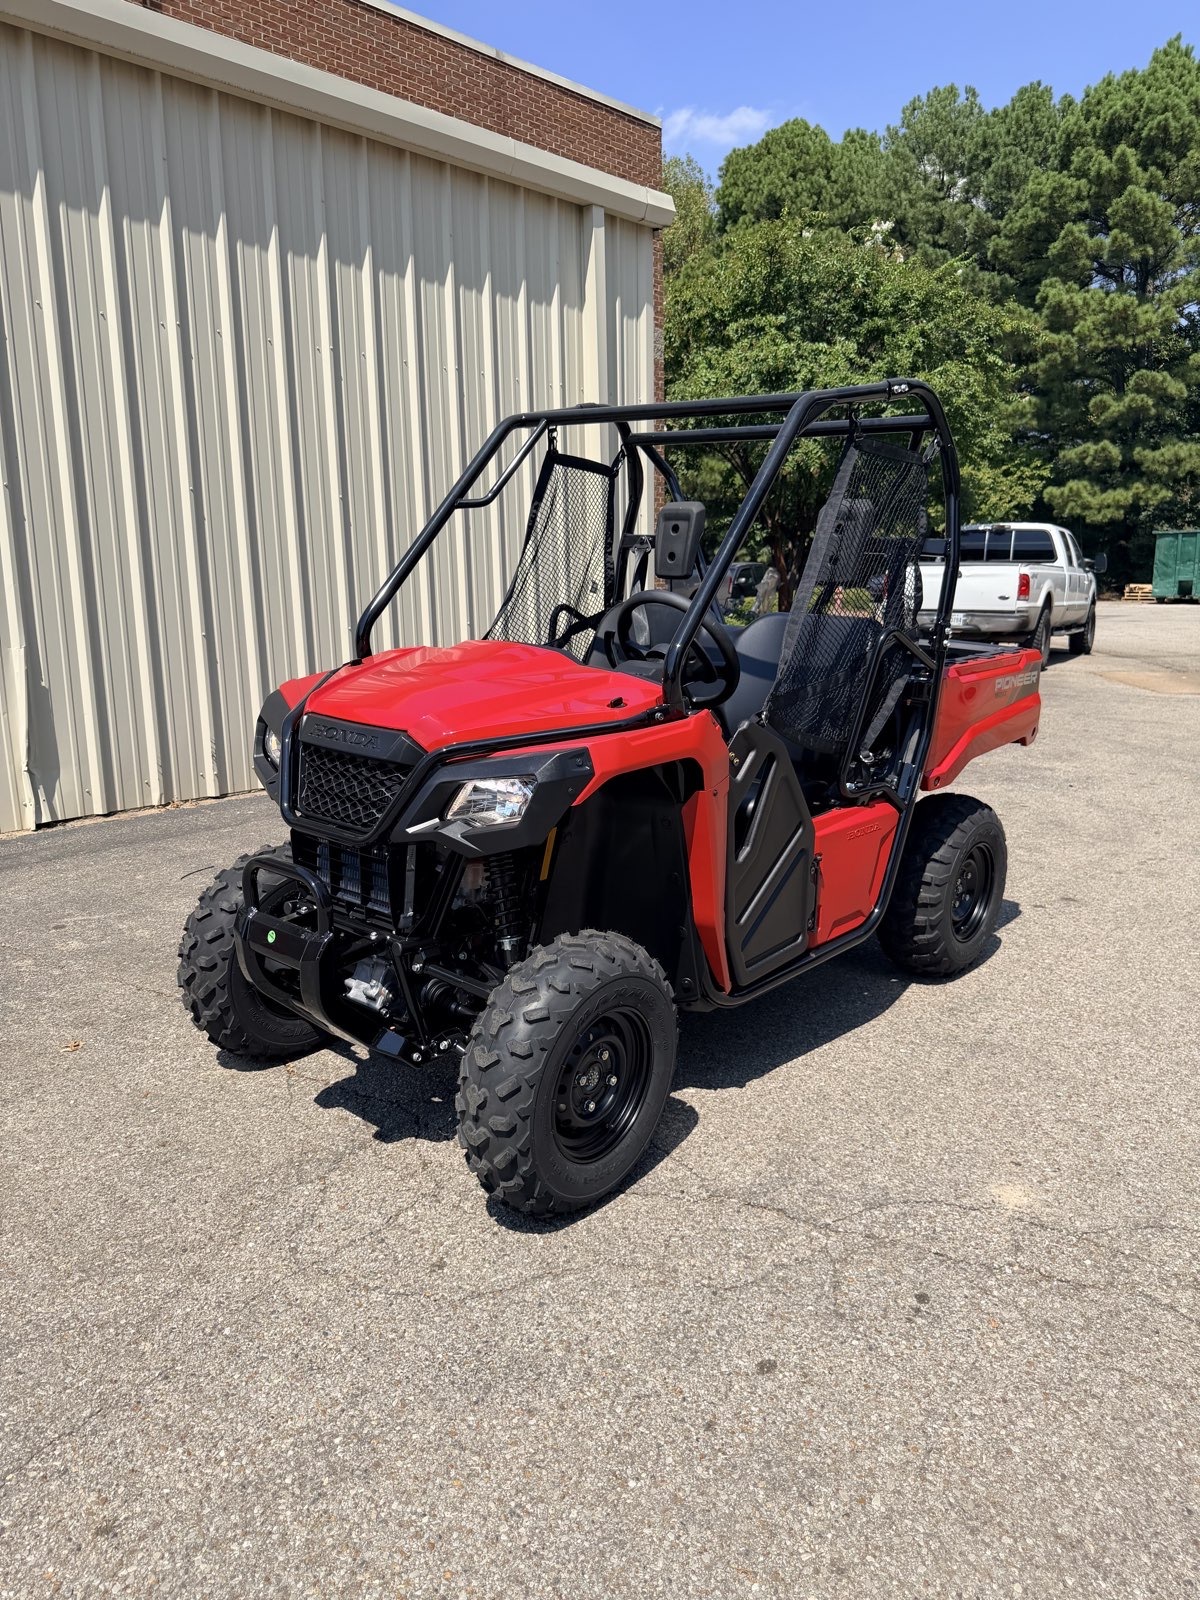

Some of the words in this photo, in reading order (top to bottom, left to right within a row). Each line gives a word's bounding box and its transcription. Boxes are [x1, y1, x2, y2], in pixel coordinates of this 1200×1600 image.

[994, 671, 1038, 692] PIONEER
[308, 723, 379, 749] HONDA
[846, 823, 881, 840] HONDA
